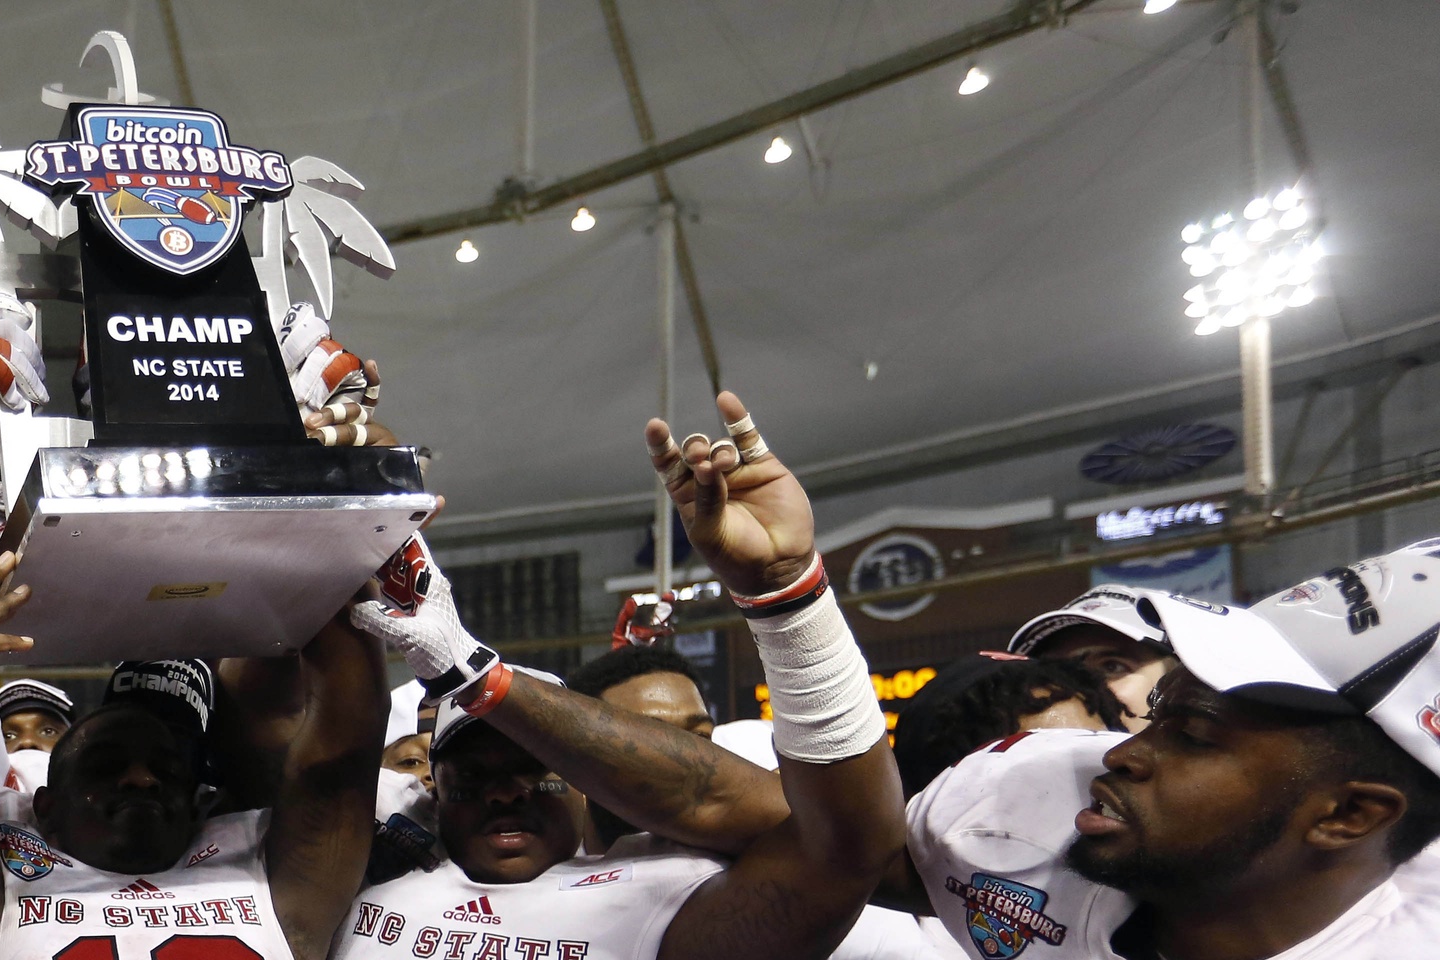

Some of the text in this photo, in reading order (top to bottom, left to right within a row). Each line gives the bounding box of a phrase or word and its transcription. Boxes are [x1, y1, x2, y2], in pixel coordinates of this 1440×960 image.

[107, 119, 203, 145] bitcoin
[78, 143, 287, 184] PETERSBURG
[116, 174, 213, 188] BOWL
[106, 316, 253, 344] CHAMP
[132, 359, 245, 378] NC STATE
[167, 384, 220, 402] 2014
[167, 670, 189, 682] 2014
[186, 842, 220, 868] ACC
[574, 868, 624, 887] ACC
[111, 889, 176, 900] adidas
[982, 879, 1034, 906] bitcoin
[18, 895, 262, 928] NC STATE
[354, 901, 406, 946] NC
[443, 907, 502, 926] adidas
[966, 887, 1066, 943] PETERSBURG
[978, 904, 1021, 931] BOWL
